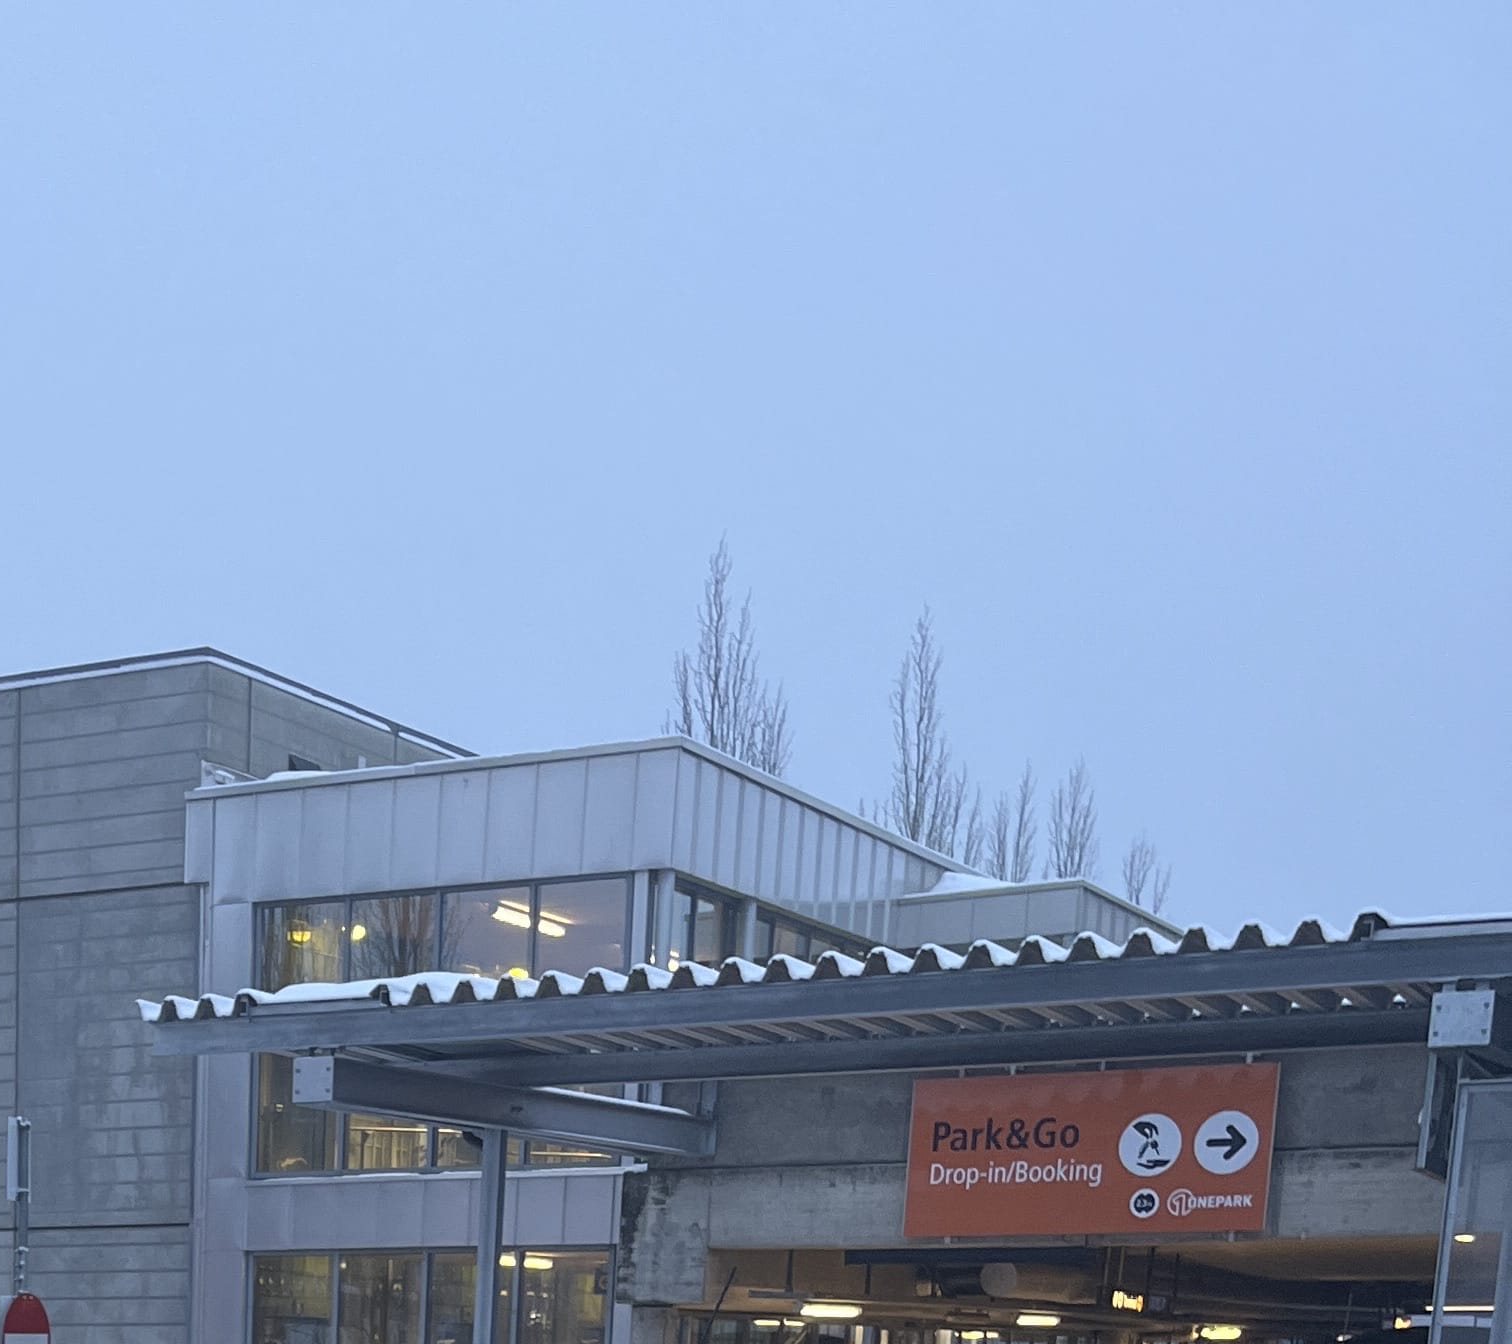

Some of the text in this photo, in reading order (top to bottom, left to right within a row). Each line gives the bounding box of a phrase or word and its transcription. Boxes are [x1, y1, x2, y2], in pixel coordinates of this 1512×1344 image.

[932, 1117, 1080, 1152] Park&Go
[930, 1158, 1102, 1190] Drop-in/Booking
[1188, 1194, 1253, 1209] ONEPARK
